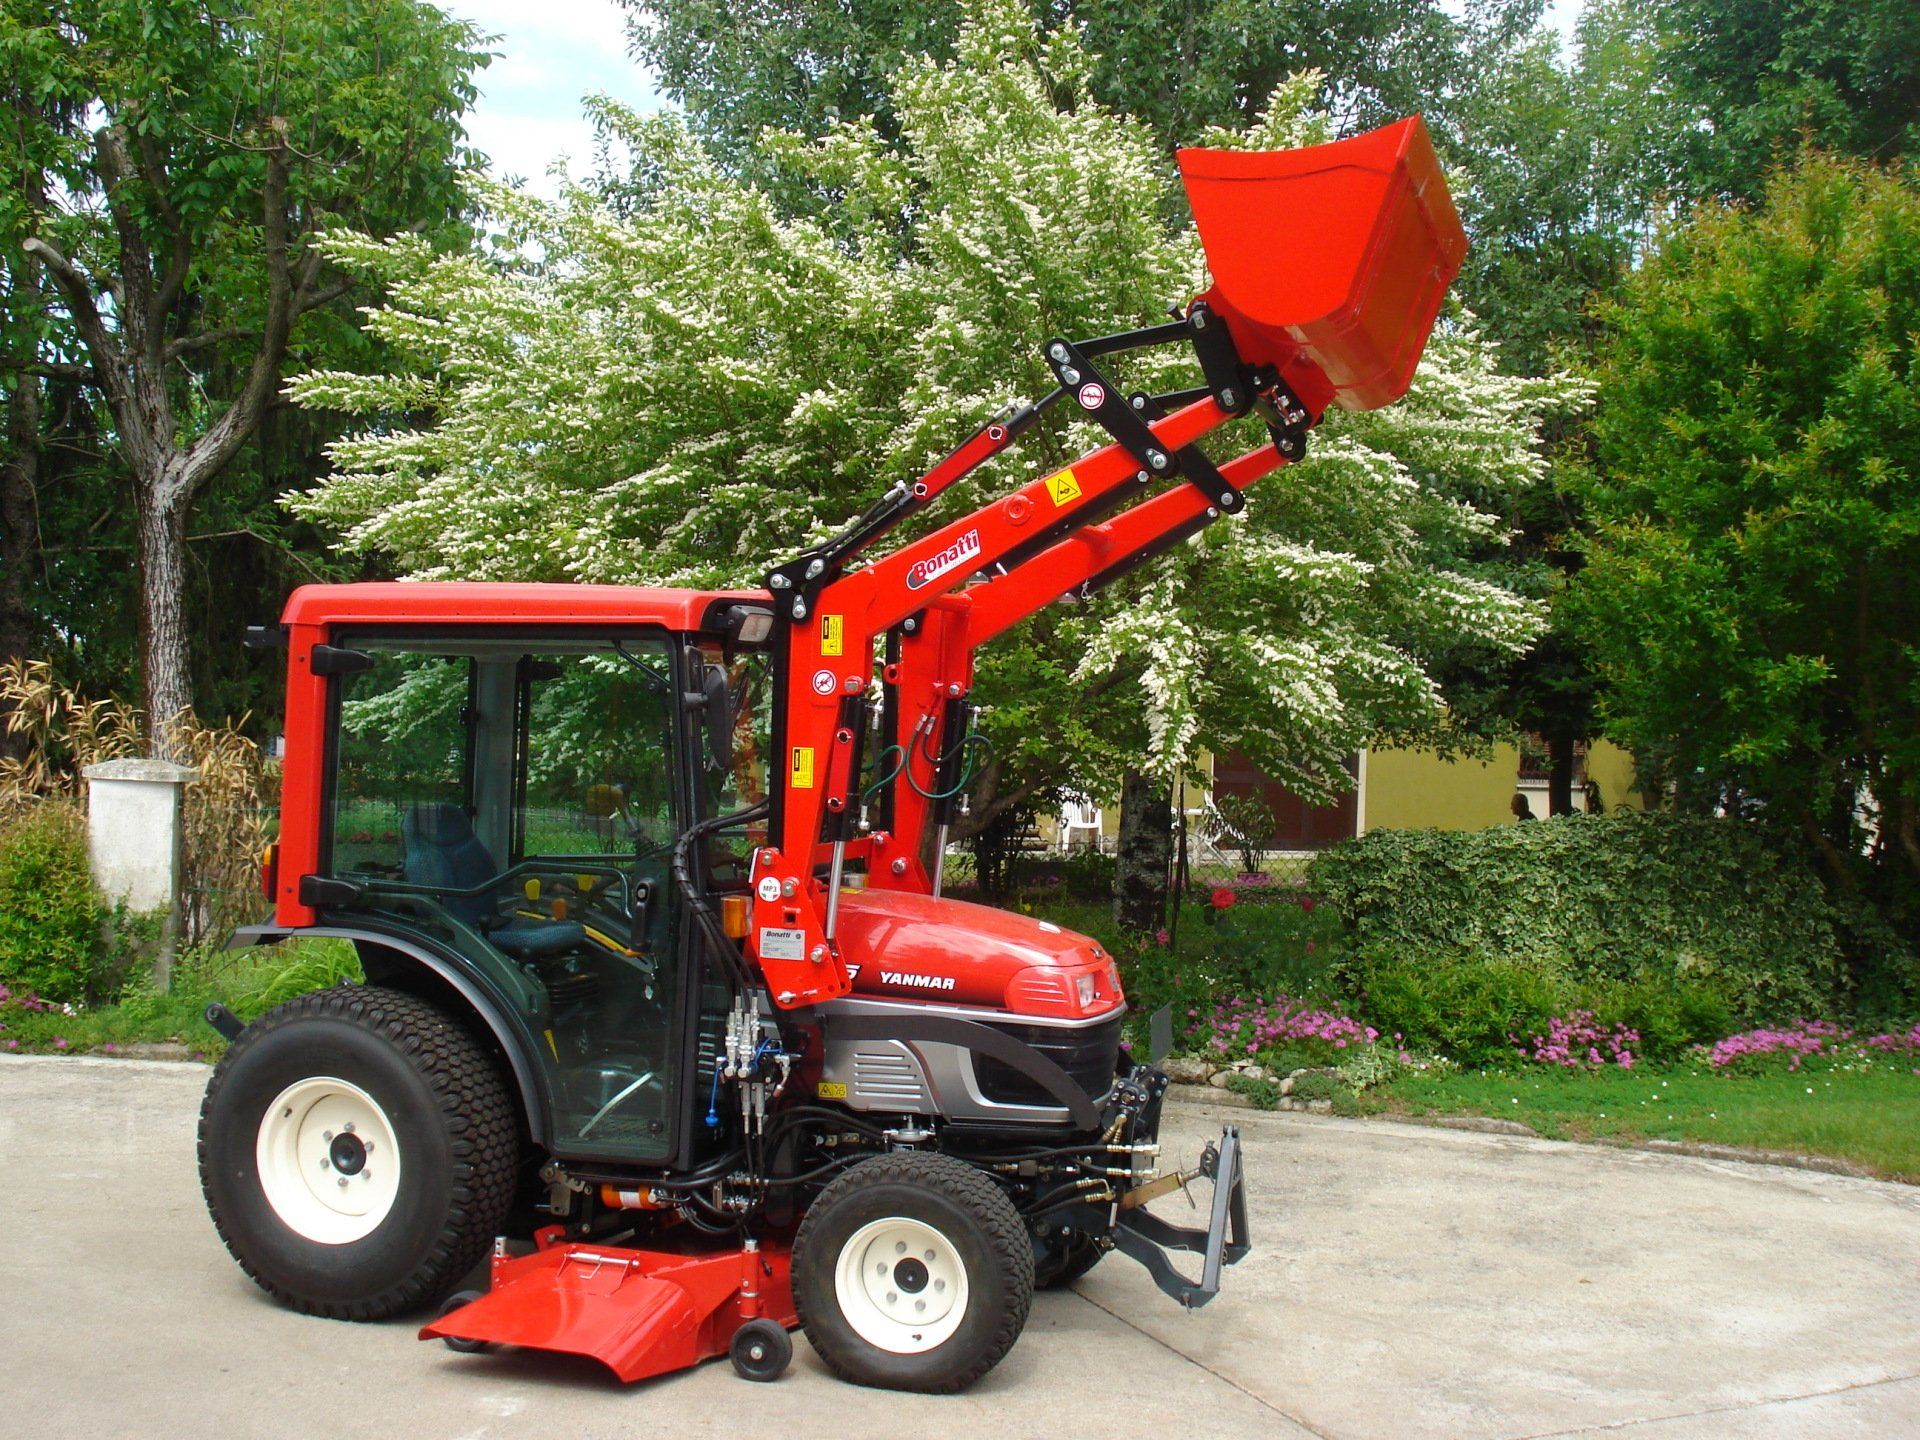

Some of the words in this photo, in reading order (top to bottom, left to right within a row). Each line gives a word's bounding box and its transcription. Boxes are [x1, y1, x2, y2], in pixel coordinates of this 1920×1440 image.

[912, 530, 978, 583] Bonatti
[762, 884, 777, 893] MP3
[766, 930, 791, 938] Bonatti
[880, 971, 956, 990] YANMAR
